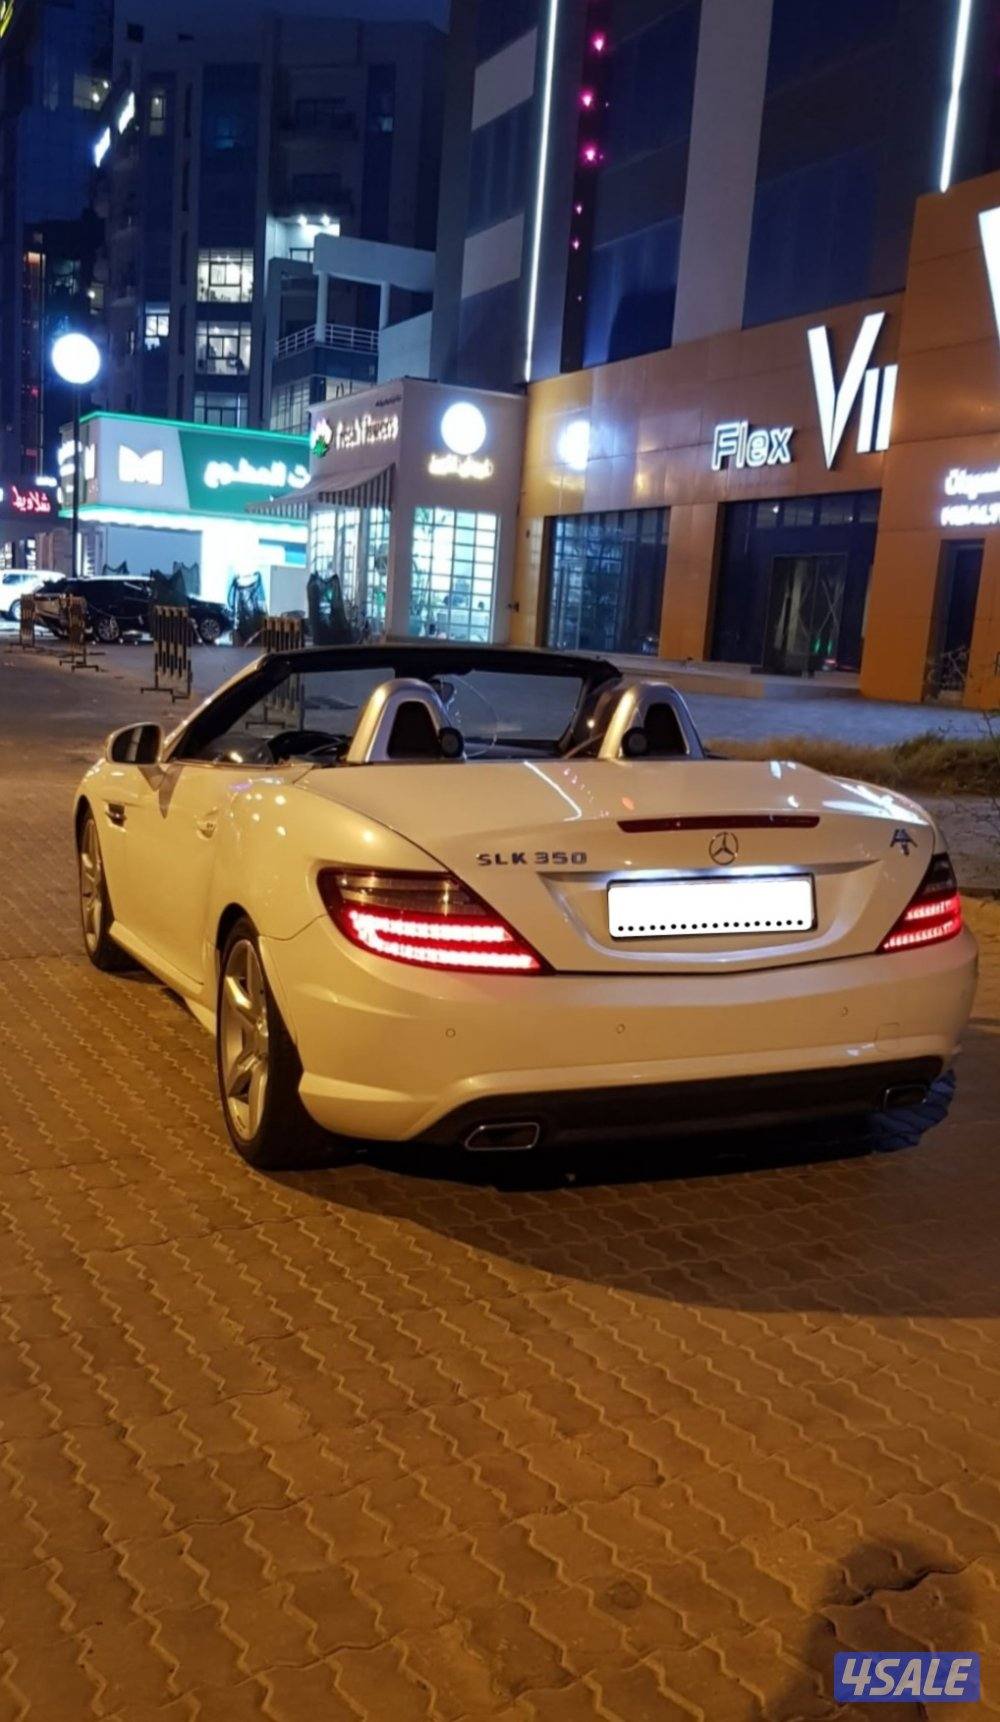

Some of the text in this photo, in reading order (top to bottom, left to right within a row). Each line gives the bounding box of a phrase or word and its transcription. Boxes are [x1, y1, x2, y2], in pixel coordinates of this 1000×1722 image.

[711, 421, 793, 470] Flex
[476, 851, 587, 866] SLK 350
